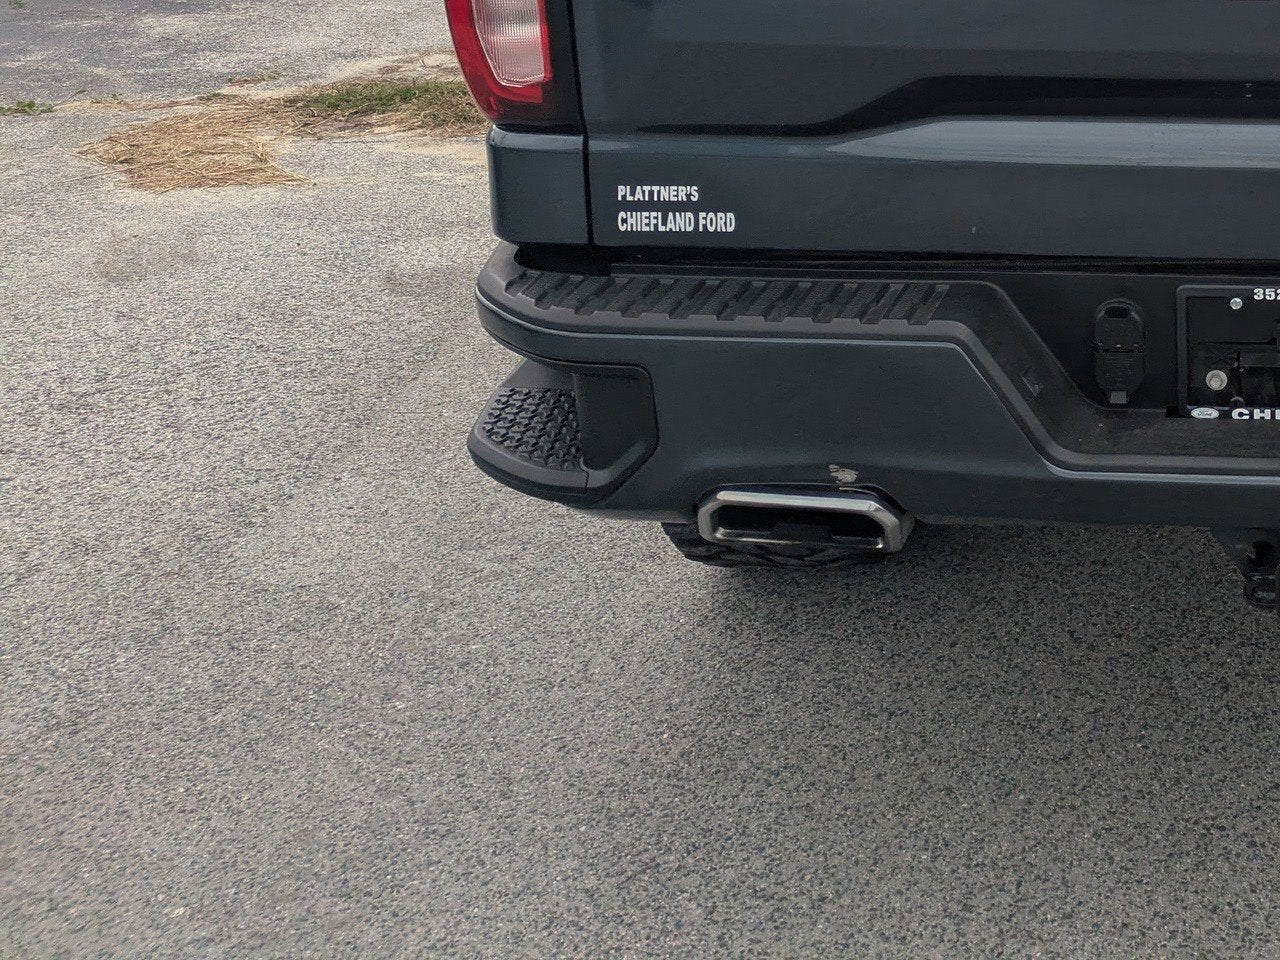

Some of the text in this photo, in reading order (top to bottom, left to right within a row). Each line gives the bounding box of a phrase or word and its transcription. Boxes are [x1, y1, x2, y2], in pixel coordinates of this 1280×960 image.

[617, 185, 699, 202] PLATTNER'S
[617, 211, 736, 232] CHIEFLAND FORD
